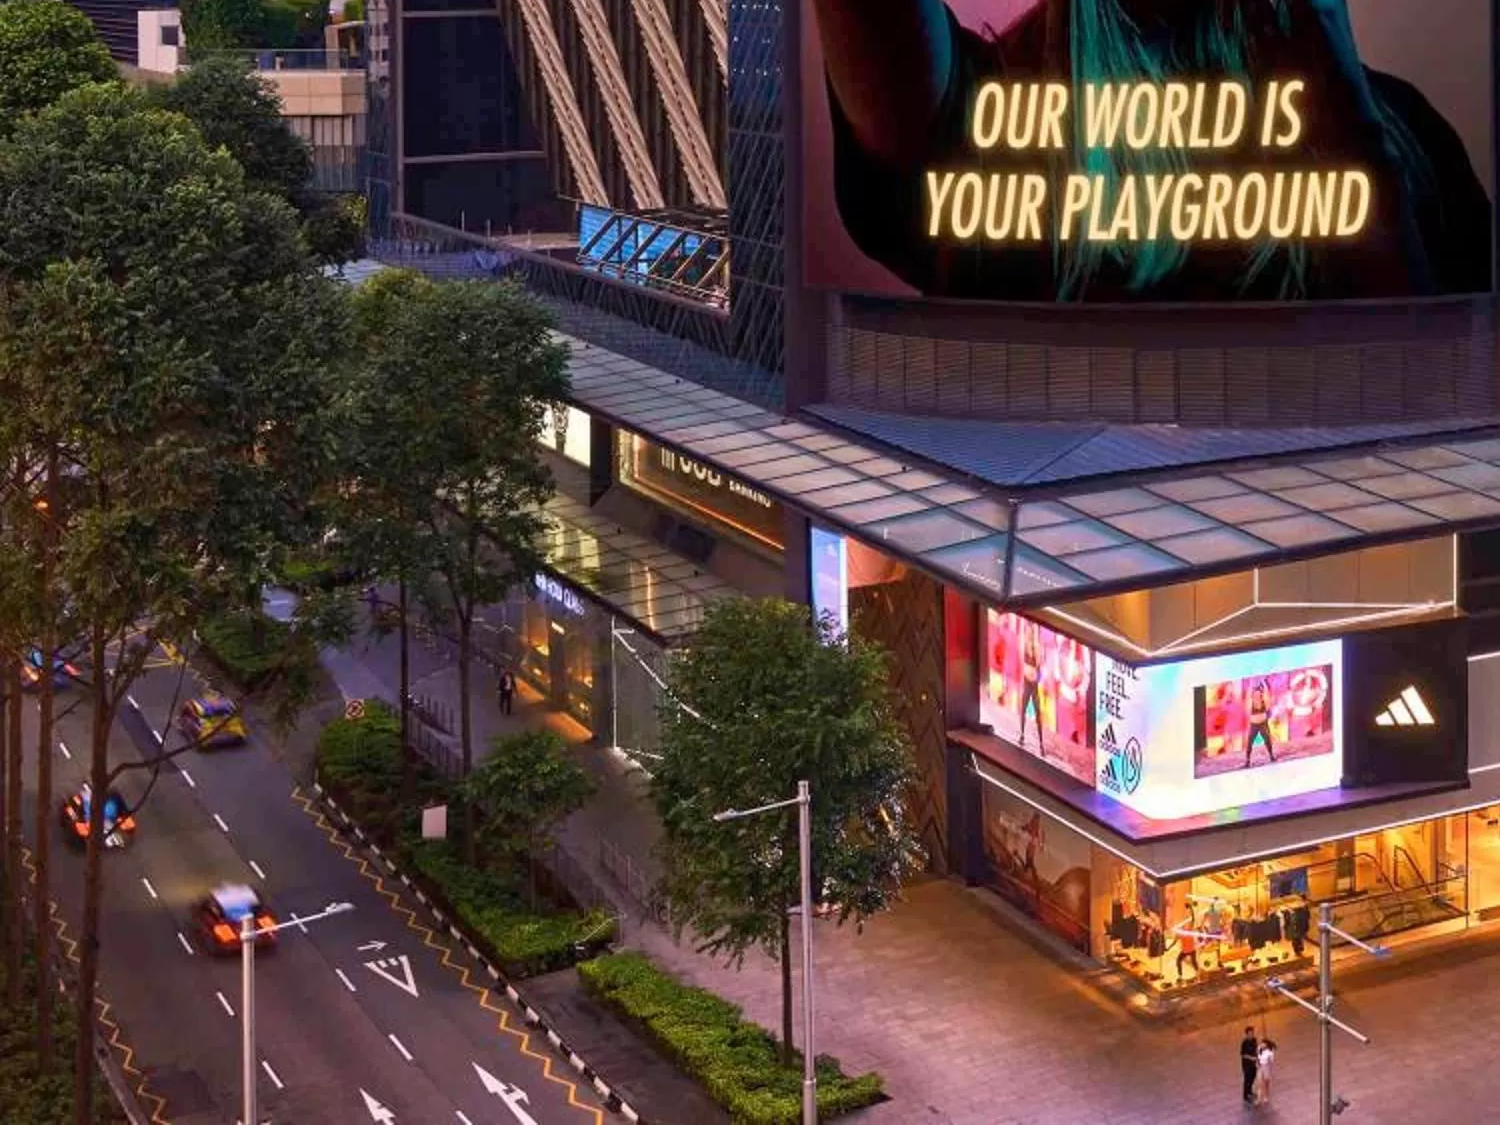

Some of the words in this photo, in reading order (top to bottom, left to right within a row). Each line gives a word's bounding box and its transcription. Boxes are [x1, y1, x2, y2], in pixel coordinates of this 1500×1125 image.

[973, 81, 1069, 149] OUR
[1085, 81, 1246, 150] WORLD
[1261, 80, 1305, 148] IS
[926, 171, 1047, 241] YOUR
[1060, 170, 1371, 242] PLAYGROUND
